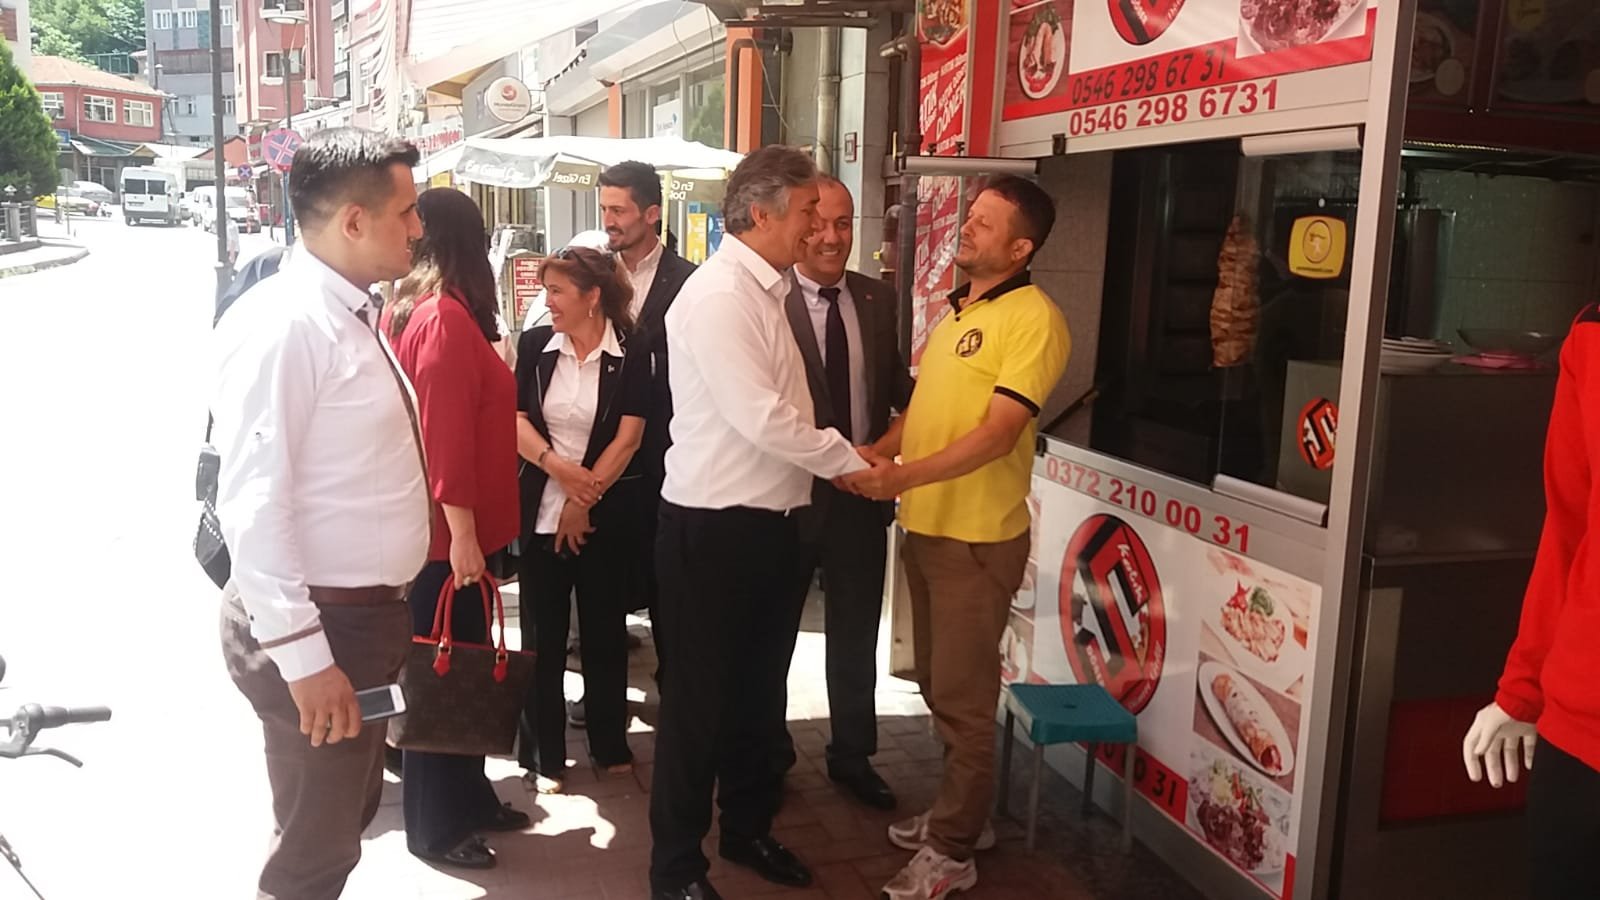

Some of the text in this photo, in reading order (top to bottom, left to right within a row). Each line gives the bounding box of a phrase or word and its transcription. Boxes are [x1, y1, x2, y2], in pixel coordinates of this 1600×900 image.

[1072, 47, 1226, 105] 0546 298 67 31
[1069, 79, 1278, 136] 0546 298 6731
[1046, 457, 1249, 554] 0372 210 00 31
[1152, 768, 1178, 808] 31
